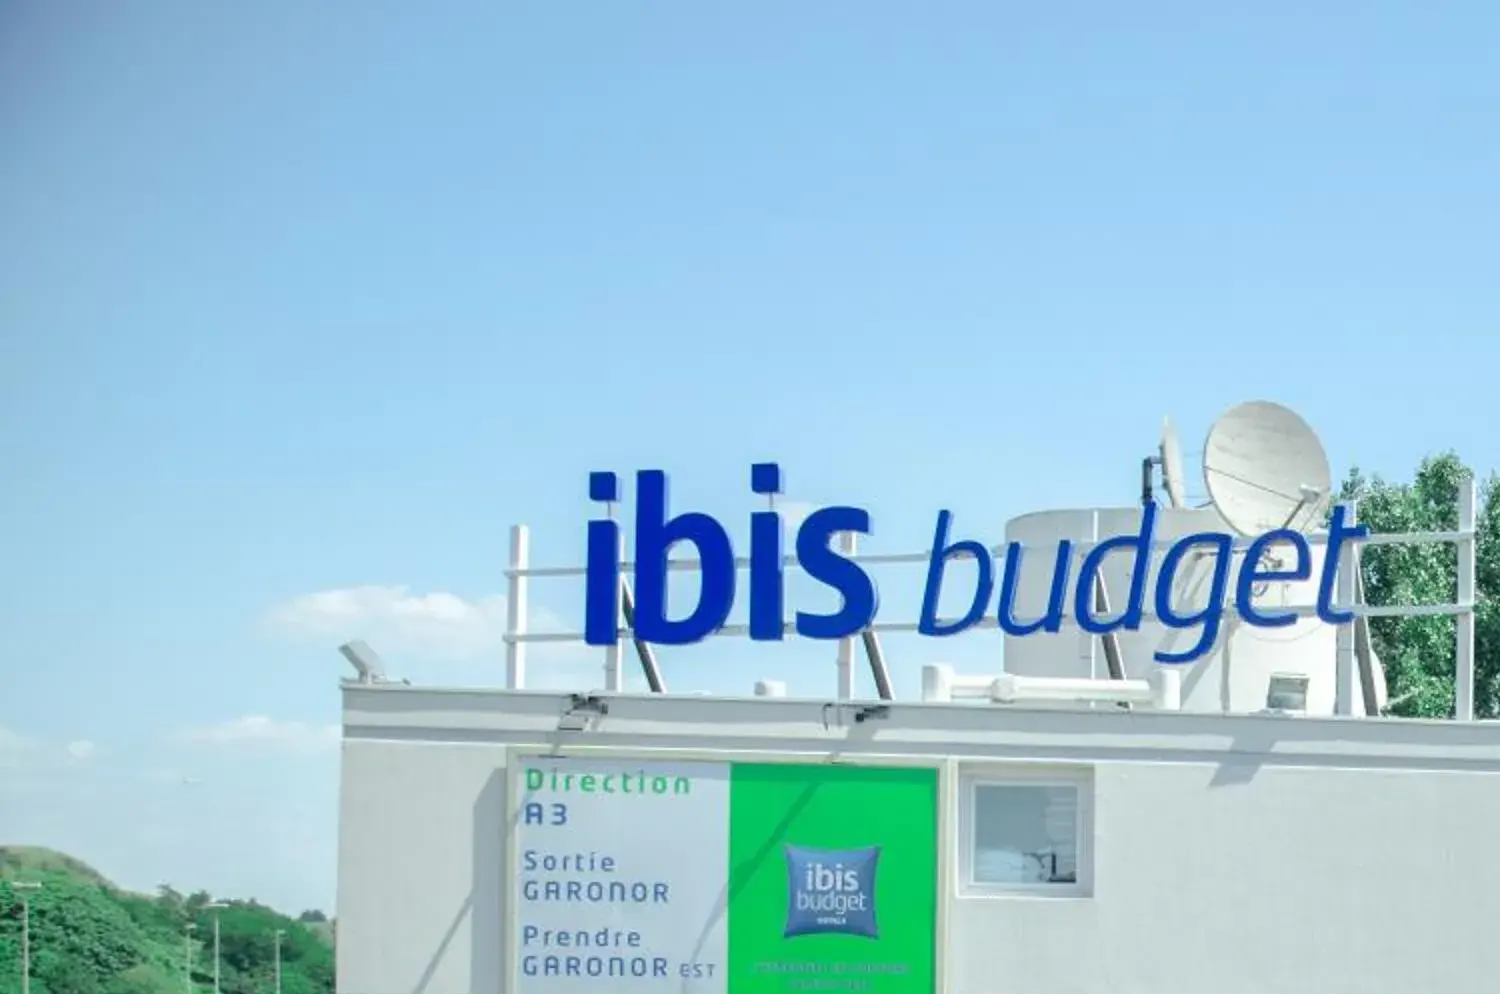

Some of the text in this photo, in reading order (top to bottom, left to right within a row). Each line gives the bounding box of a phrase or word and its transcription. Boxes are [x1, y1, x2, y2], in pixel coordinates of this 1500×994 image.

[583, 461, 1367, 663] ibis budget
[525, 768, 690, 794] Direction
[523, 851, 616, 873] Sortie
[805, 863, 860, 891] ibis
[523, 880, 669, 903] GARONOR
[796, 891, 867, 915] budget
[523, 926, 642, 948] Prendre
[522, 956, 716, 979] GARONOR EST
